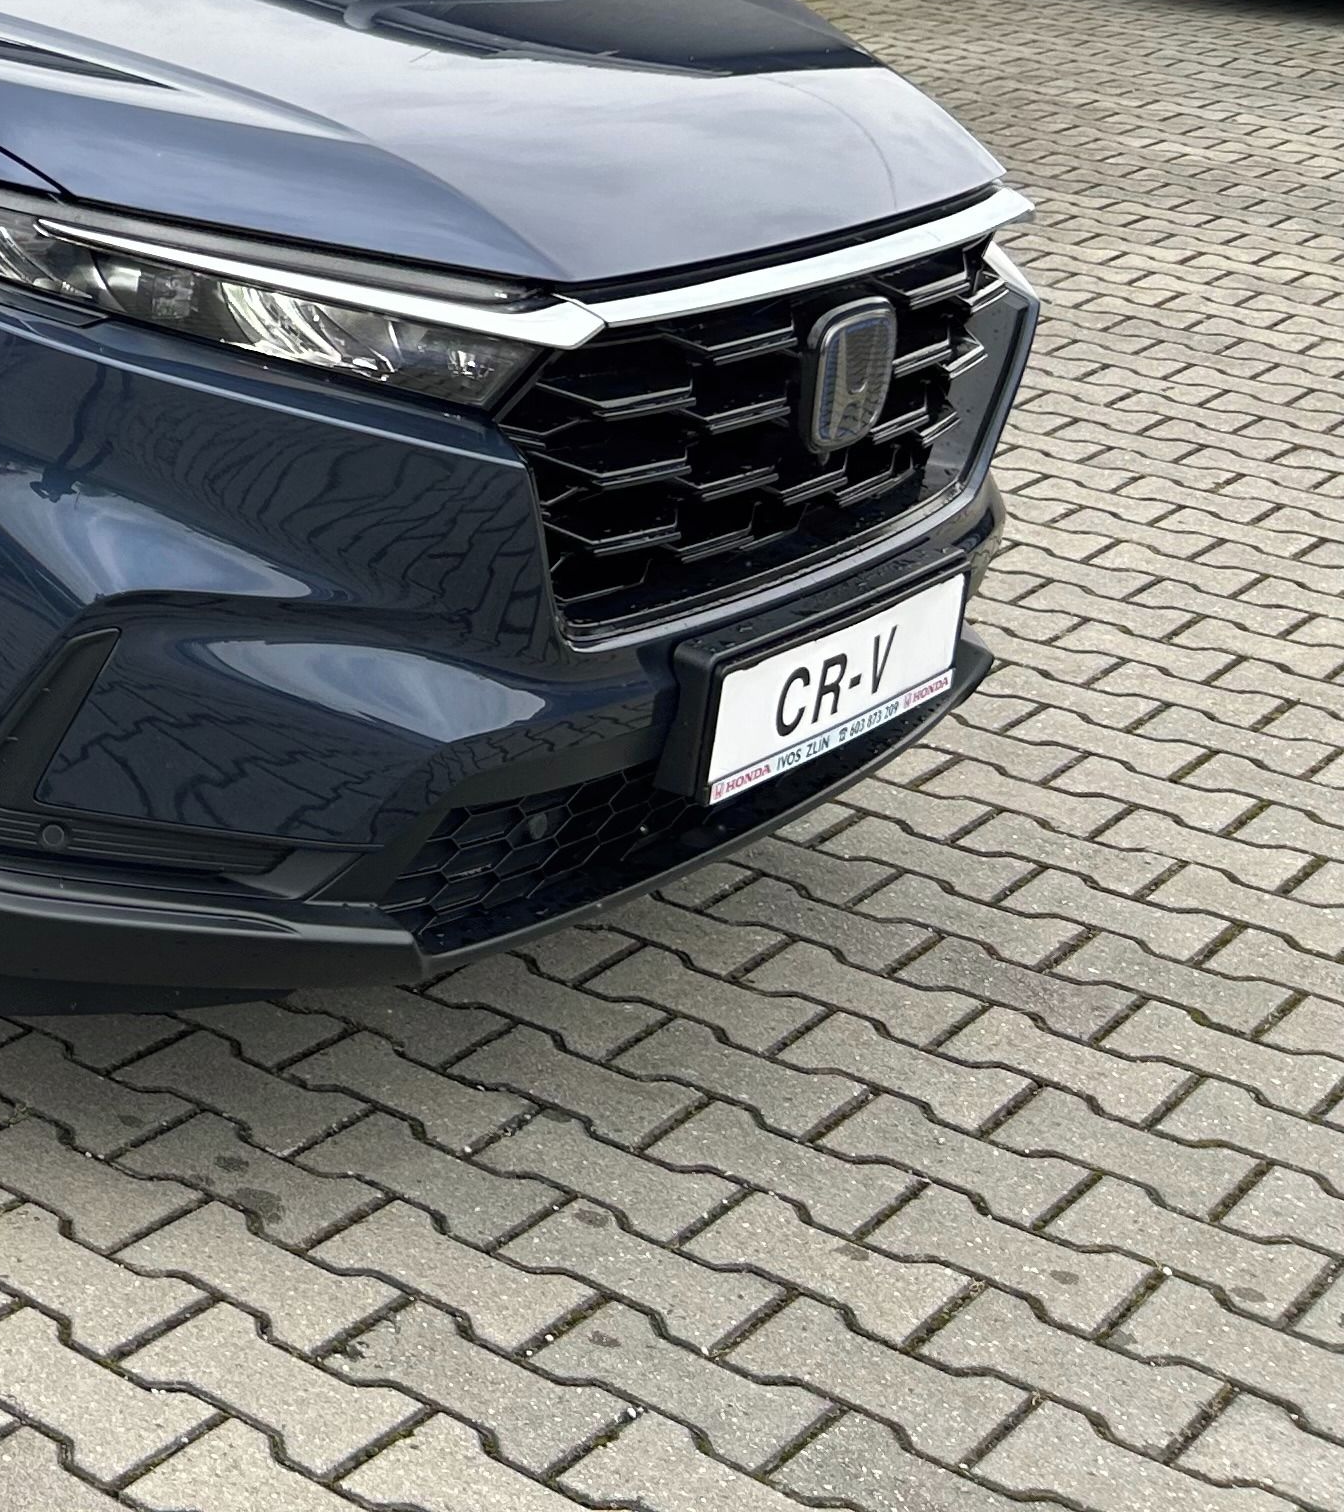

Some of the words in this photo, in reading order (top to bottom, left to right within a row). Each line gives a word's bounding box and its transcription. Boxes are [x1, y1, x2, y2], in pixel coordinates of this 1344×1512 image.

[725, 764, 771, 792] HONDA
[776, 749, 802, 771] IVOS
[805, 735, 831, 758] ZLÍN
[850, 718, 866, 736] 603
[867, 711, 882, 728] 873
[884, 701, 899, 719] 209
[912, 675, 949, 703] HONDA
[775, 624, 898, 737] CR-V
